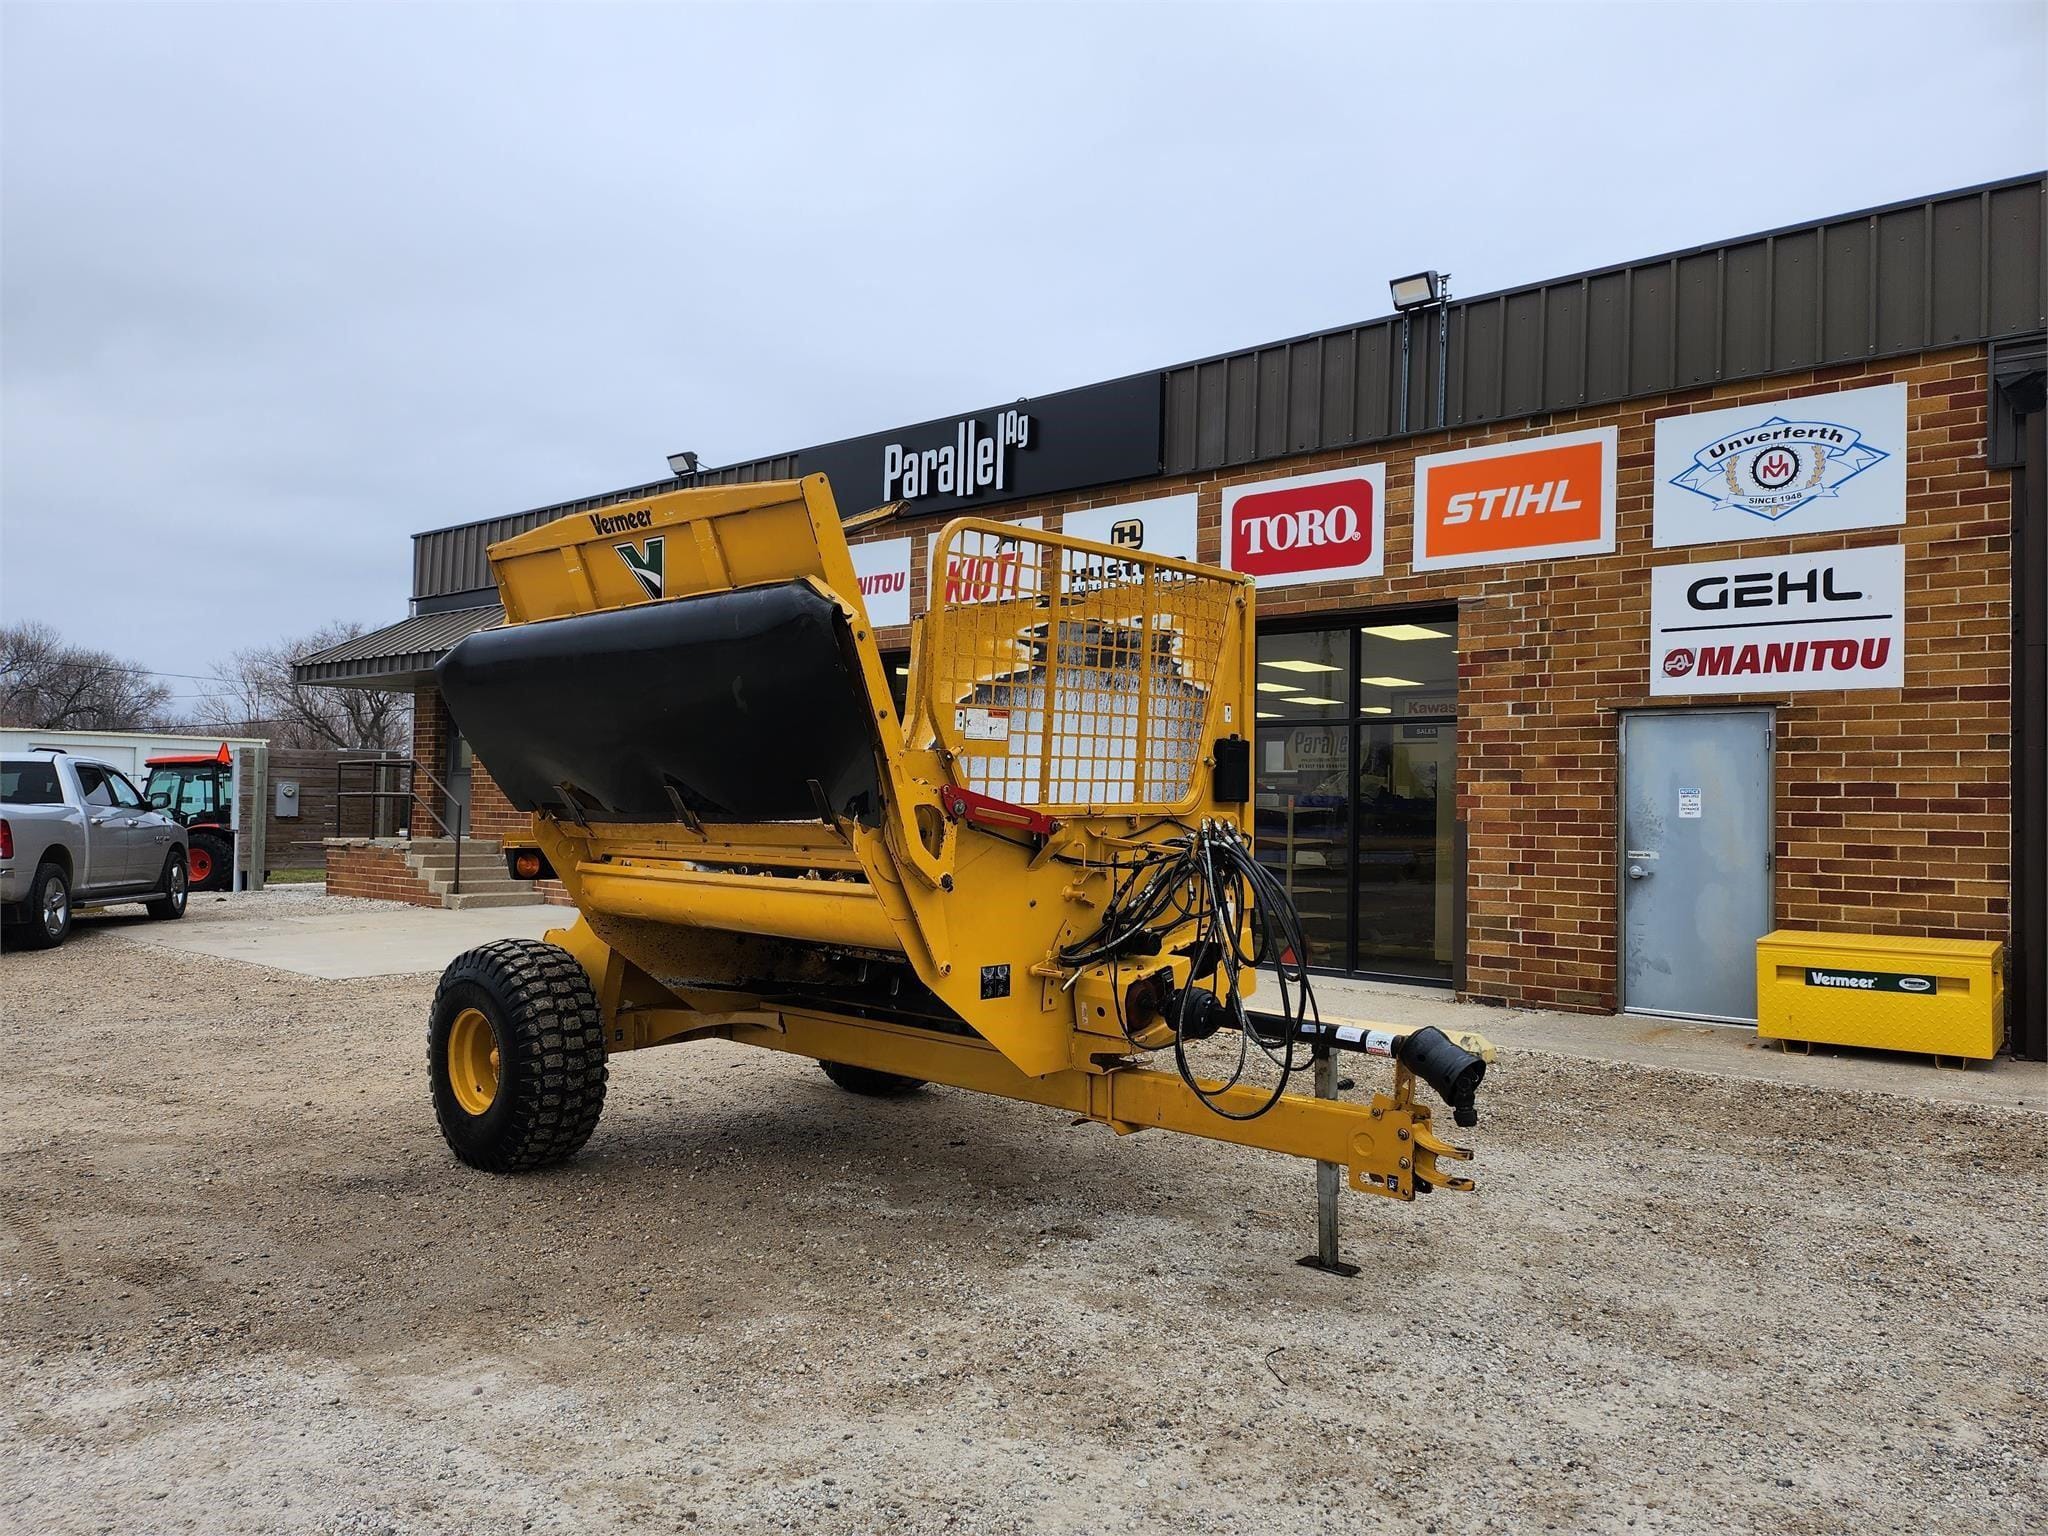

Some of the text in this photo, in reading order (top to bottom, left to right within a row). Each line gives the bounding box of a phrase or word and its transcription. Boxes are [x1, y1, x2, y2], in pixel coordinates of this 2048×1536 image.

[884, 409, 1029, 501] Parallel Ag
[1708, 426, 1843, 459] Unverferth
[1442, 479, 1582, 525] STIHL
[1748, 492, 1803, 505] SINCE 1948
[589, 510, 652, 535] Vermeer
[1240, 505, 1359, 555] TORO
[1687, 567, 1863, 611] GEHL
[1697, 637, 1891, 677] MANITOU
[1811, 971, 1874, 988] Vermeer
